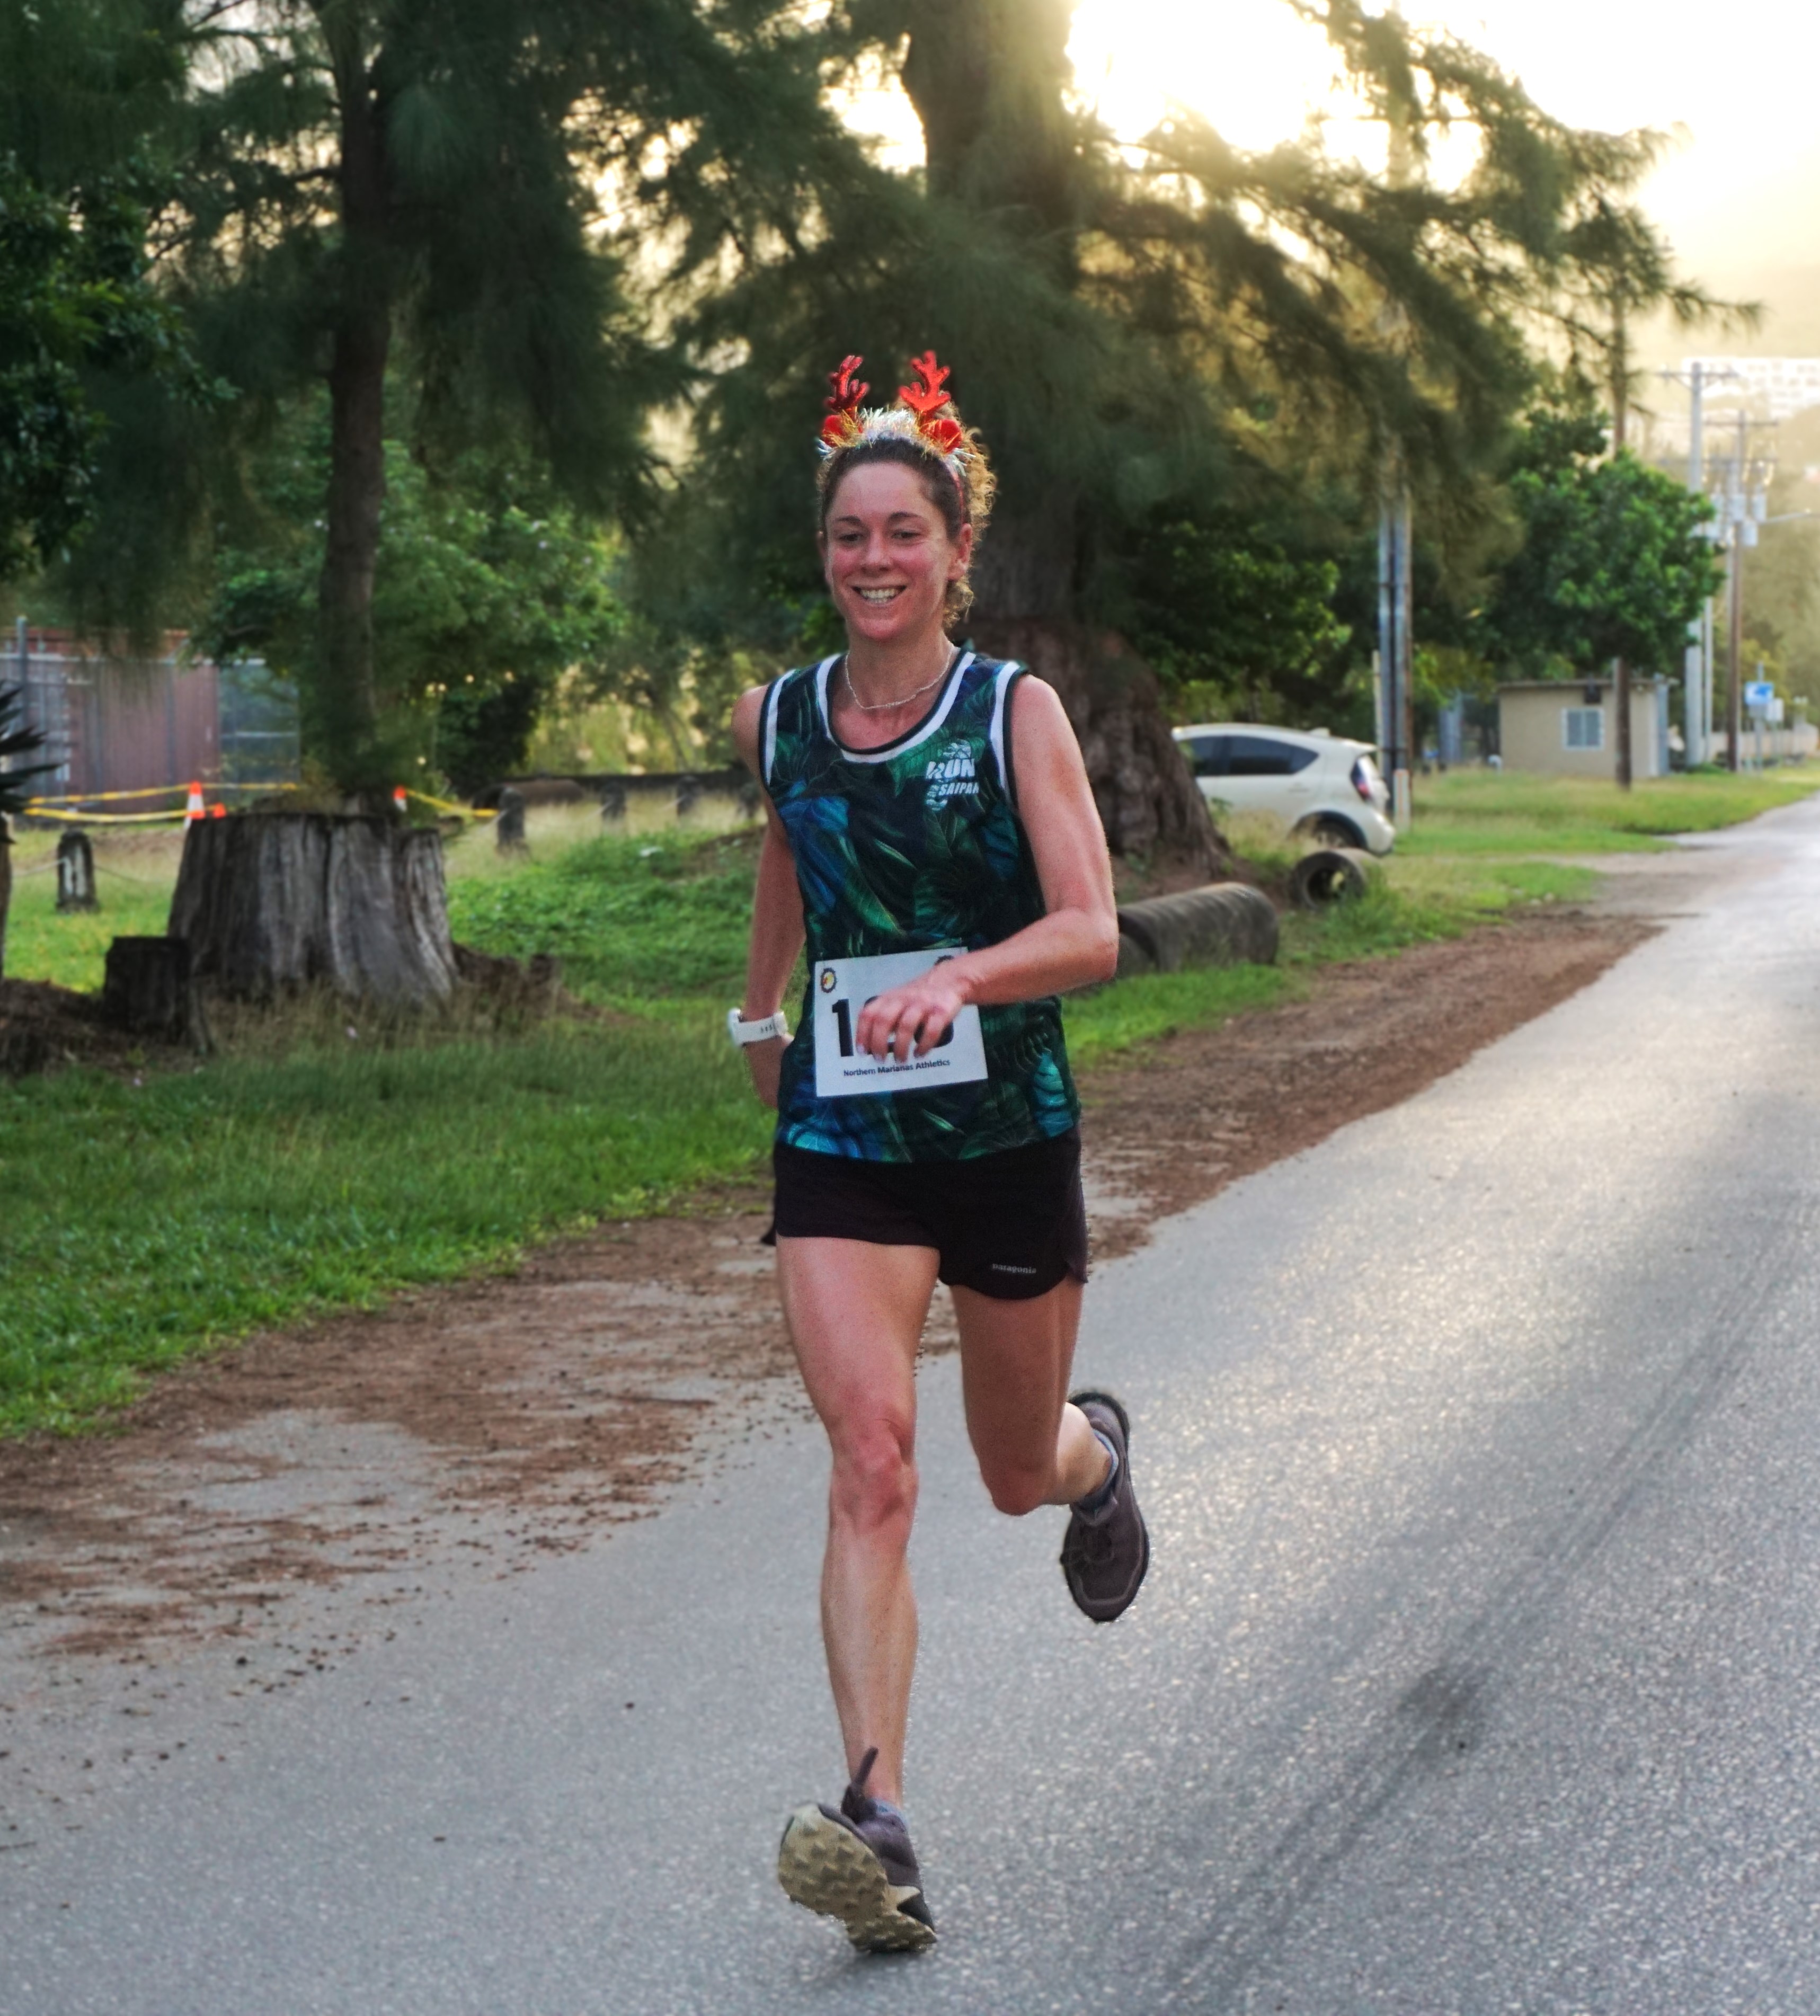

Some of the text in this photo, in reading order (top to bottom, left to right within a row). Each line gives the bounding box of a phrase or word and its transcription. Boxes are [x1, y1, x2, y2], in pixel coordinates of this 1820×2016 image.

[926, 759, 975, 779] RUN
[938, 782, 979, 796] SAIPAN
[844, 1059, 951, 1077] Northern Marianas Athletics
[992, 1263, 1036, 1274] patagonia
